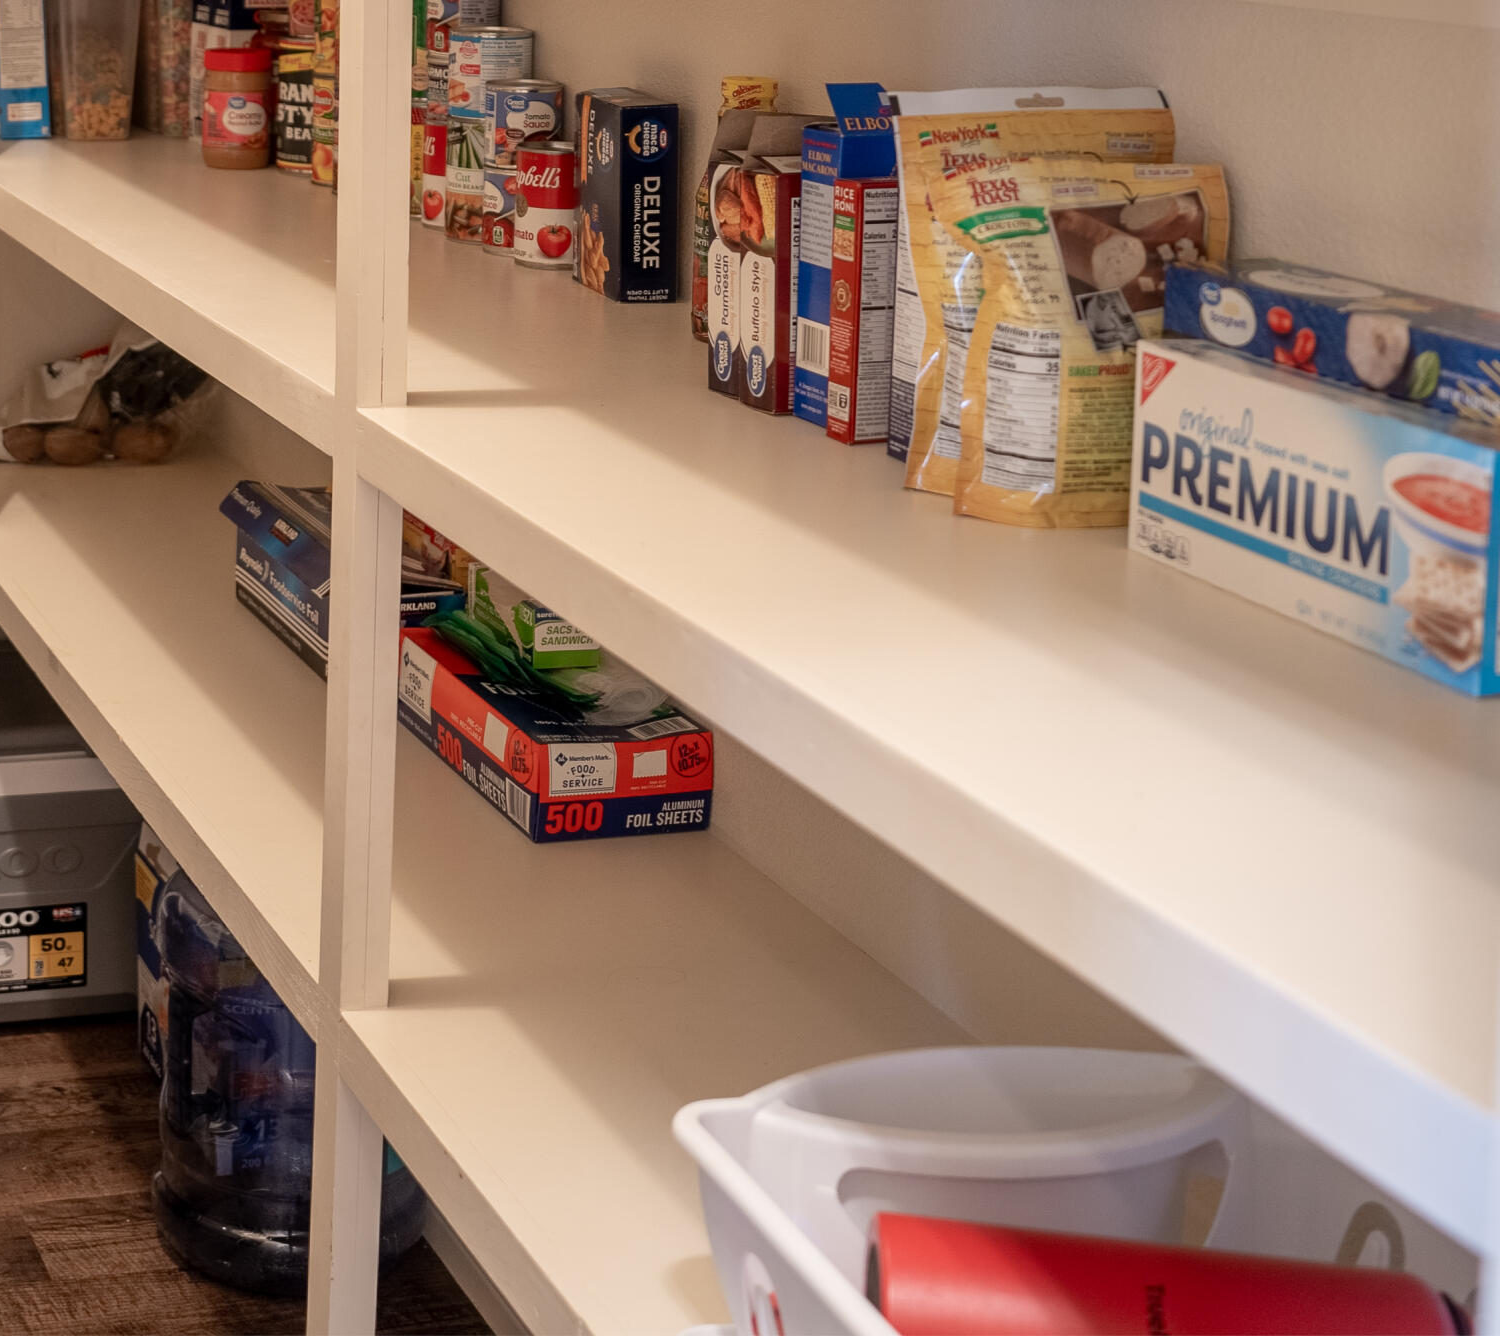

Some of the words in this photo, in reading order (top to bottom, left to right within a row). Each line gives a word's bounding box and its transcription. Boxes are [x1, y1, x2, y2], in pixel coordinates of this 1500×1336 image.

[523, 120, 550, 129] Sauce
[588, 110, 596, 175] DELUXE
[807, 149, 832, 163] ELBOW
[940, 148, 987, 170] TEXAS
[455, 171, 471, 183] Cut
[802, 160, 838, 177] MACARONI
[834, 186, 854, 200] RICE
[865, 190, 898, 200] Nutrition
[967, 177, 1018, 195] TEXAS
[971, 189, 1020, 207] TOAST
[643, 176, 661, 269] DELUXE
[633, 224, 641, 263] CHEDDAR
[864, 232, 886, 240] Calories
[714, 253, 722, 296] Garlic
[751, 261, 761, 293] Style
[721, 254, 729, 326] Parmesan
[751, 296, 760, 342] Buffalo
[996, 324, 1029, 339] Nutrition
[1032, 330, 1060, 339] Facts
[1179, 407, 1254, 461] original
[1140, 421, 1390, 577] PREMIUM
[239, 547, 264, 575] Reynolds
[269, 573, 306, 613] Foodservice
[306, 602, 320, 625] Foil
[404, 685, 425, 710] SERVICE
[436, 723, 463, 771] 500
[678, 743, 688, 757] 12
[479, 761, 506, 792] ALUMINUM
[571, 764, 596, 775] FOOD
[462, 759, 479, 788] FOIL
[478, 773, 507, 812] SHEETS
[562, 777, 604, 789] SERVICE
[662, 800, 705, 812] ALUMINUM
[545, 801, 604, 835] 500
[626, 814, 653, 828] FOIL
[656, 810, 703, 827] SHEETS
[41, 937, 66, 952] 50
[57, 957, 74, 968] 47
